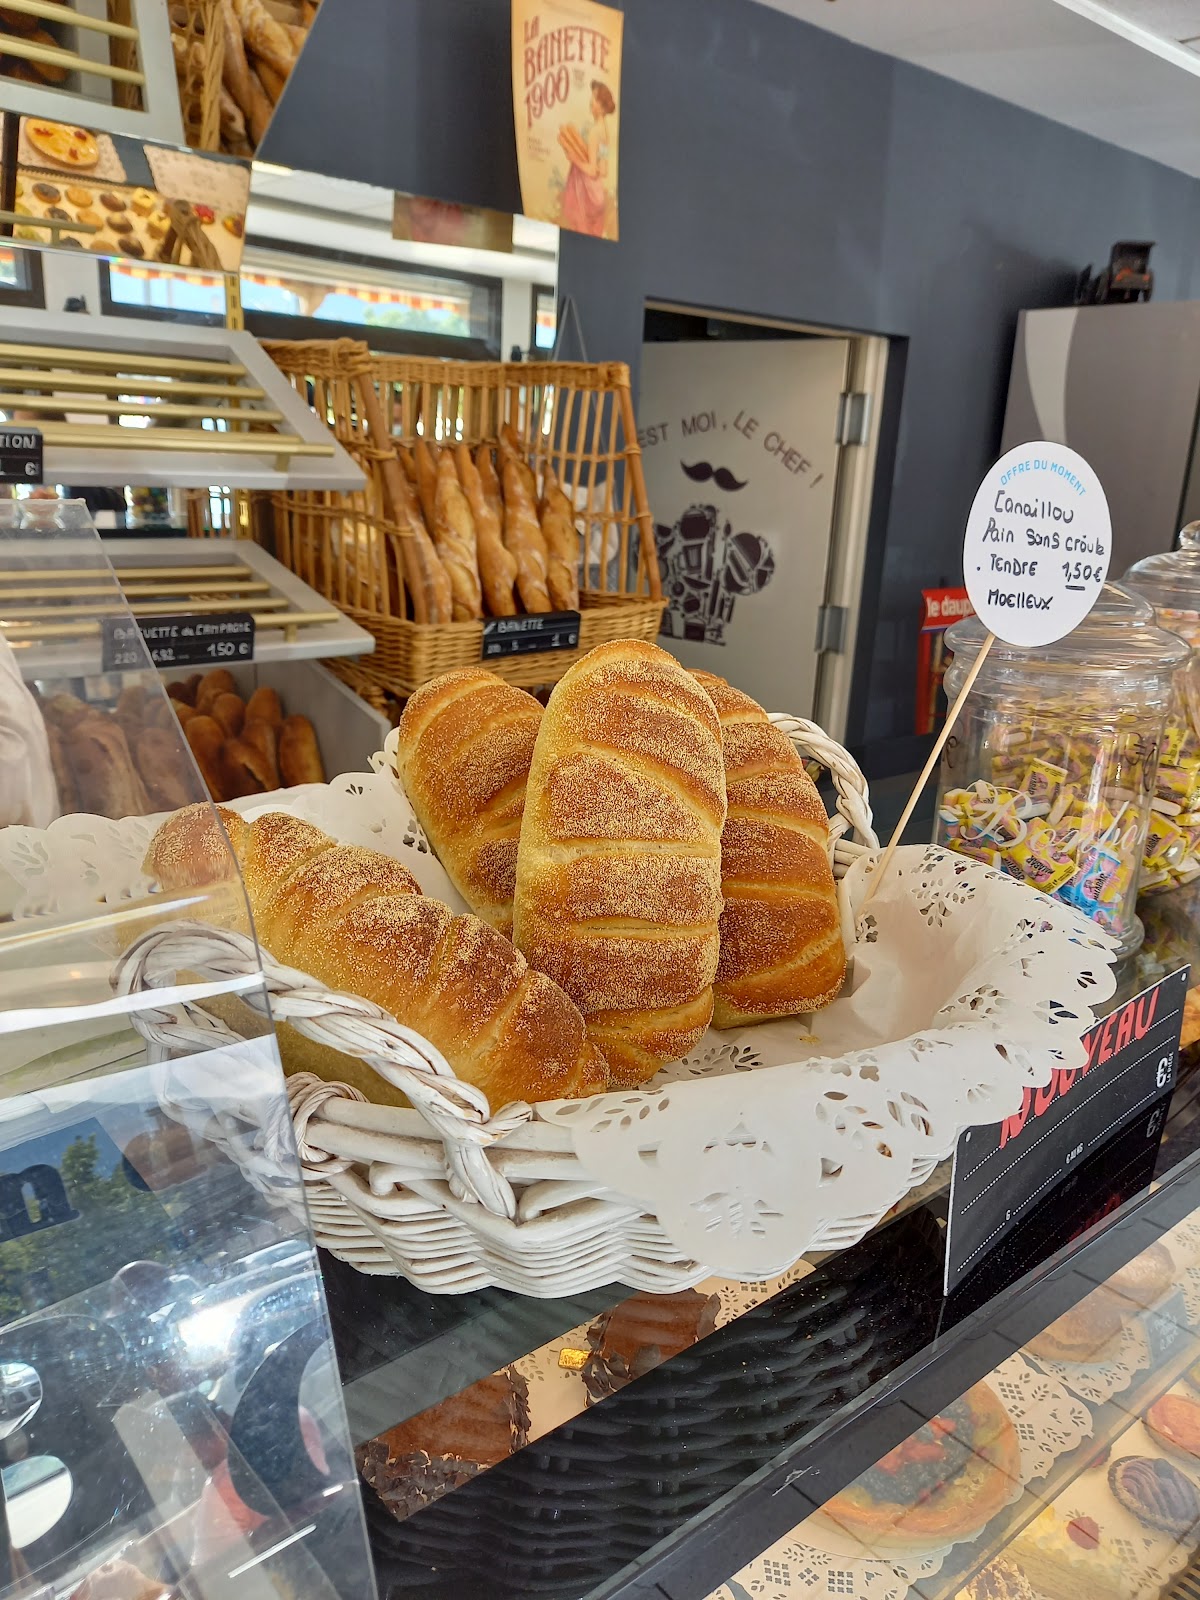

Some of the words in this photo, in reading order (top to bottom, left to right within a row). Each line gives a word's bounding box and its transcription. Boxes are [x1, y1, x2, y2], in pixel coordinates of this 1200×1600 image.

[524, 15, 539, 44] LA
[524, 25, 609, 88] BANETTE
[525, 64, 570, 129] 1900
[733, 410, 760, 440] LE
[763, 431, 812, 475] CHEF
[1001, 461, 1031, 486] OFFRE
[1034, 459, 1048, 471] DU
[1050, 462, 1087, 496] MOMENT
[994, 489, 1074, 523] Canaillou
[982, 517, 1014, 543] Pain
[926, 595, 940, 617] le
